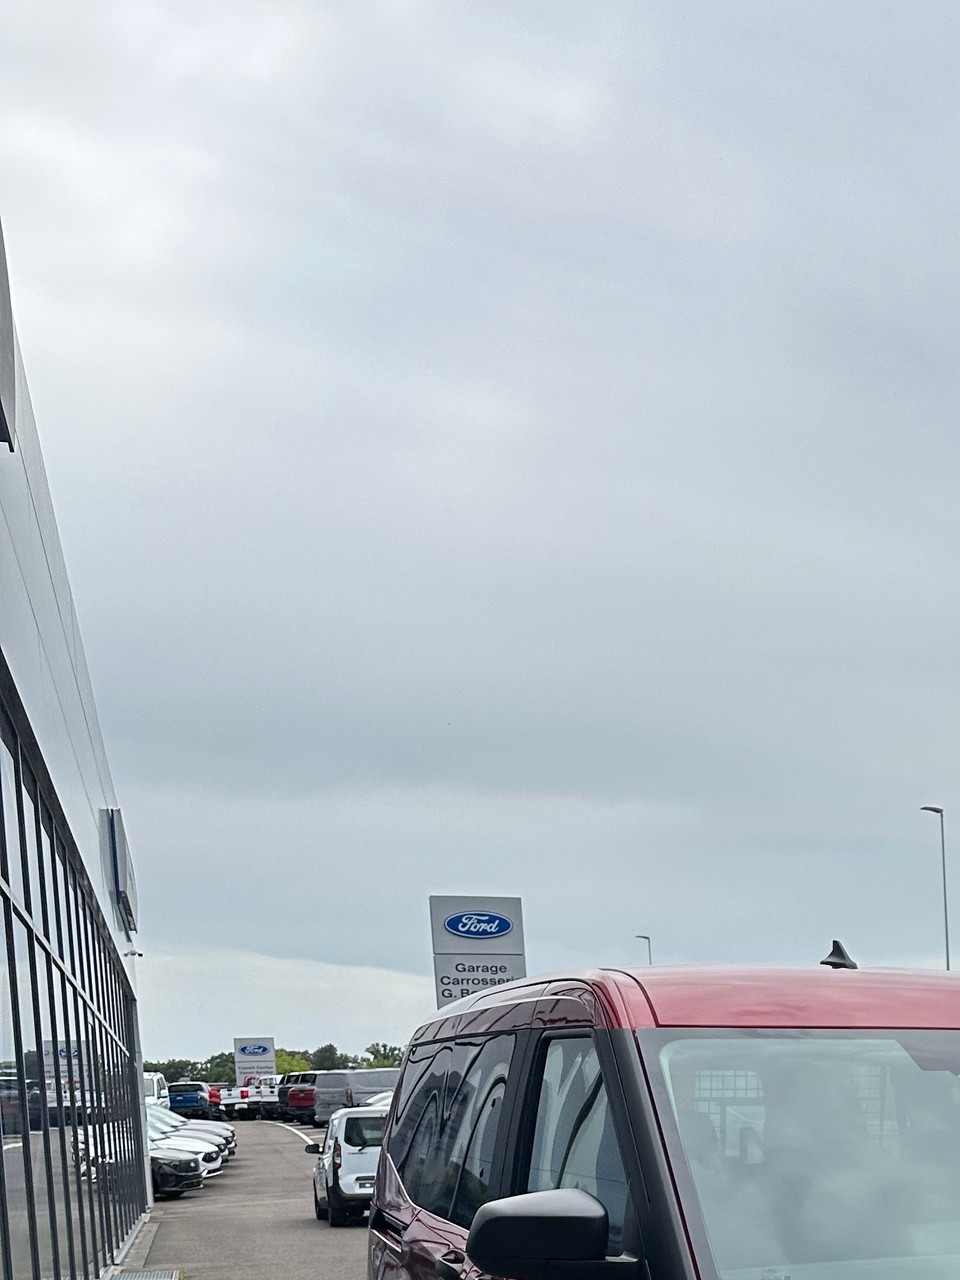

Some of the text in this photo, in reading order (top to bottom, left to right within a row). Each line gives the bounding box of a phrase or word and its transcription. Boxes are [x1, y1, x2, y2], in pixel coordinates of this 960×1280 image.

[458, 914, 500, 933] Ford
[455, 962, 508, 975] Garage
[440, 975, 520, 986] Carrosseri
[441, 988, 457, 999] G.
